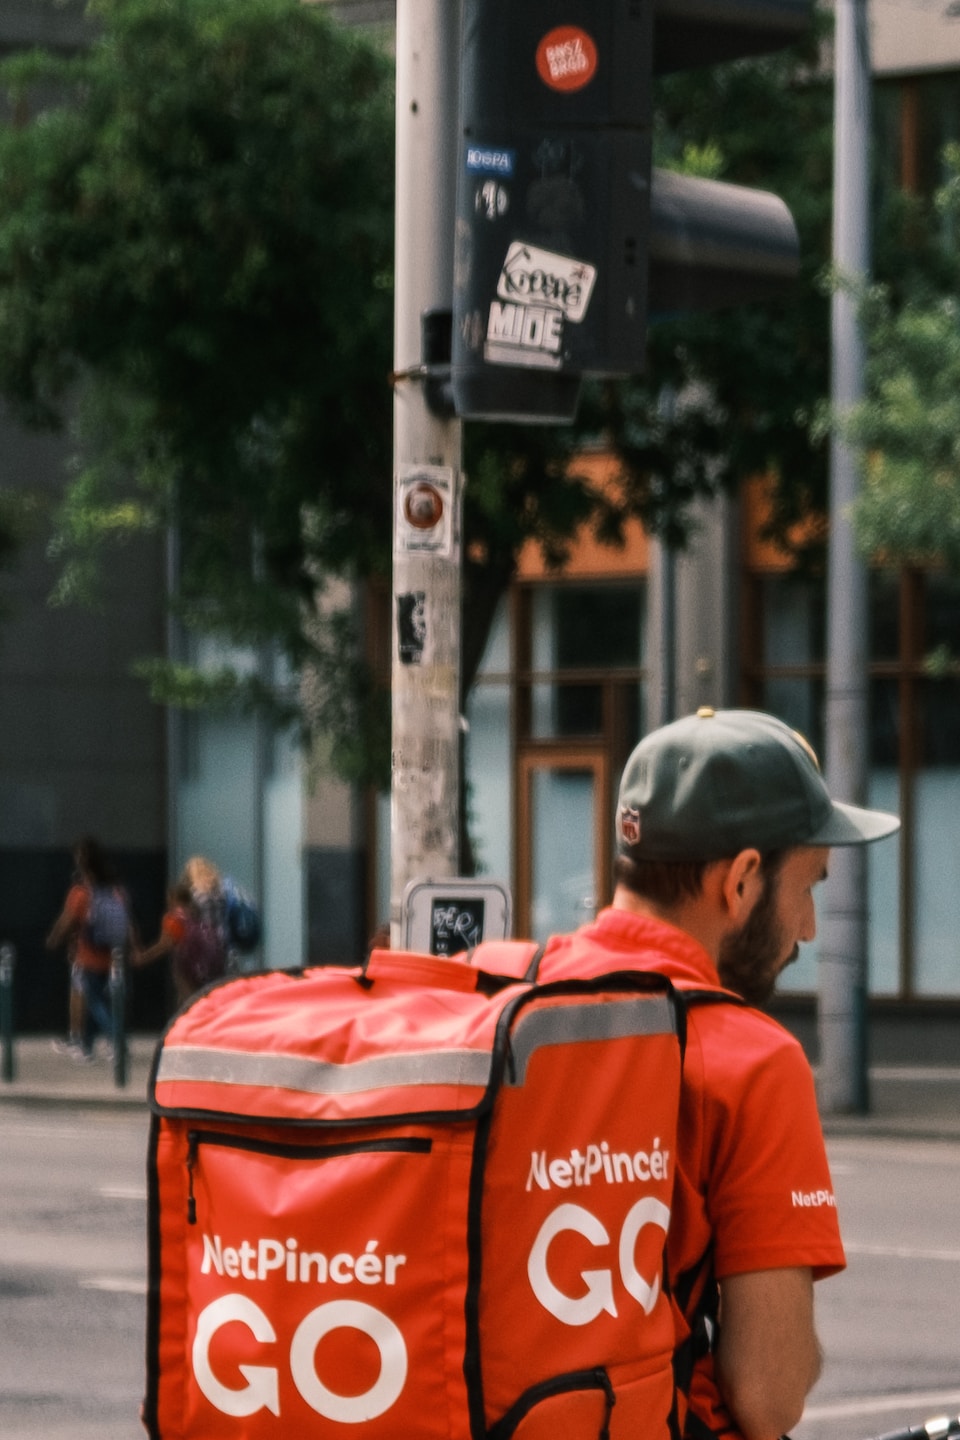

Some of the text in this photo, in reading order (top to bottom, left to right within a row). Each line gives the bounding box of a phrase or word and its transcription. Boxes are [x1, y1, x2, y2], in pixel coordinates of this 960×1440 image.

[526, 1136, 670, 1192] NetPincér
[200, 1234, 406, 1286] NetPincér
[527, 1196, 671, 1327] GO
[192, 1293, 408, 1424] GO
